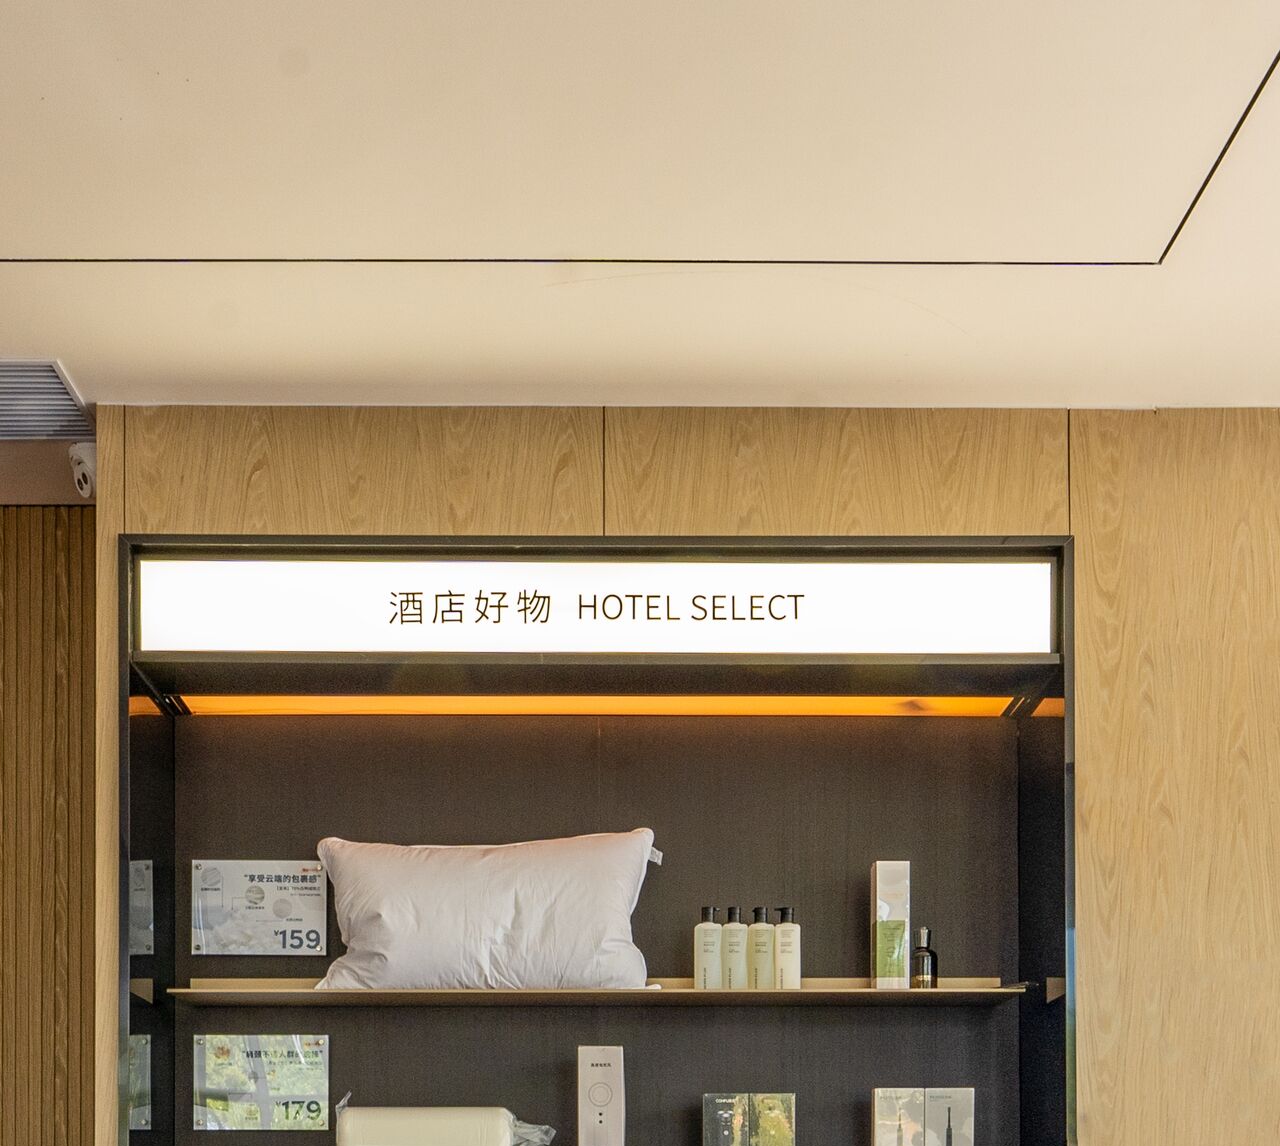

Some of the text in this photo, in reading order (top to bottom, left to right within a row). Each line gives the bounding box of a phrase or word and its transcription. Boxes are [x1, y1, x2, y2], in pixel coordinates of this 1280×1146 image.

[389, 589, 805, 624] 酒店好物 HOTEL SELECT
